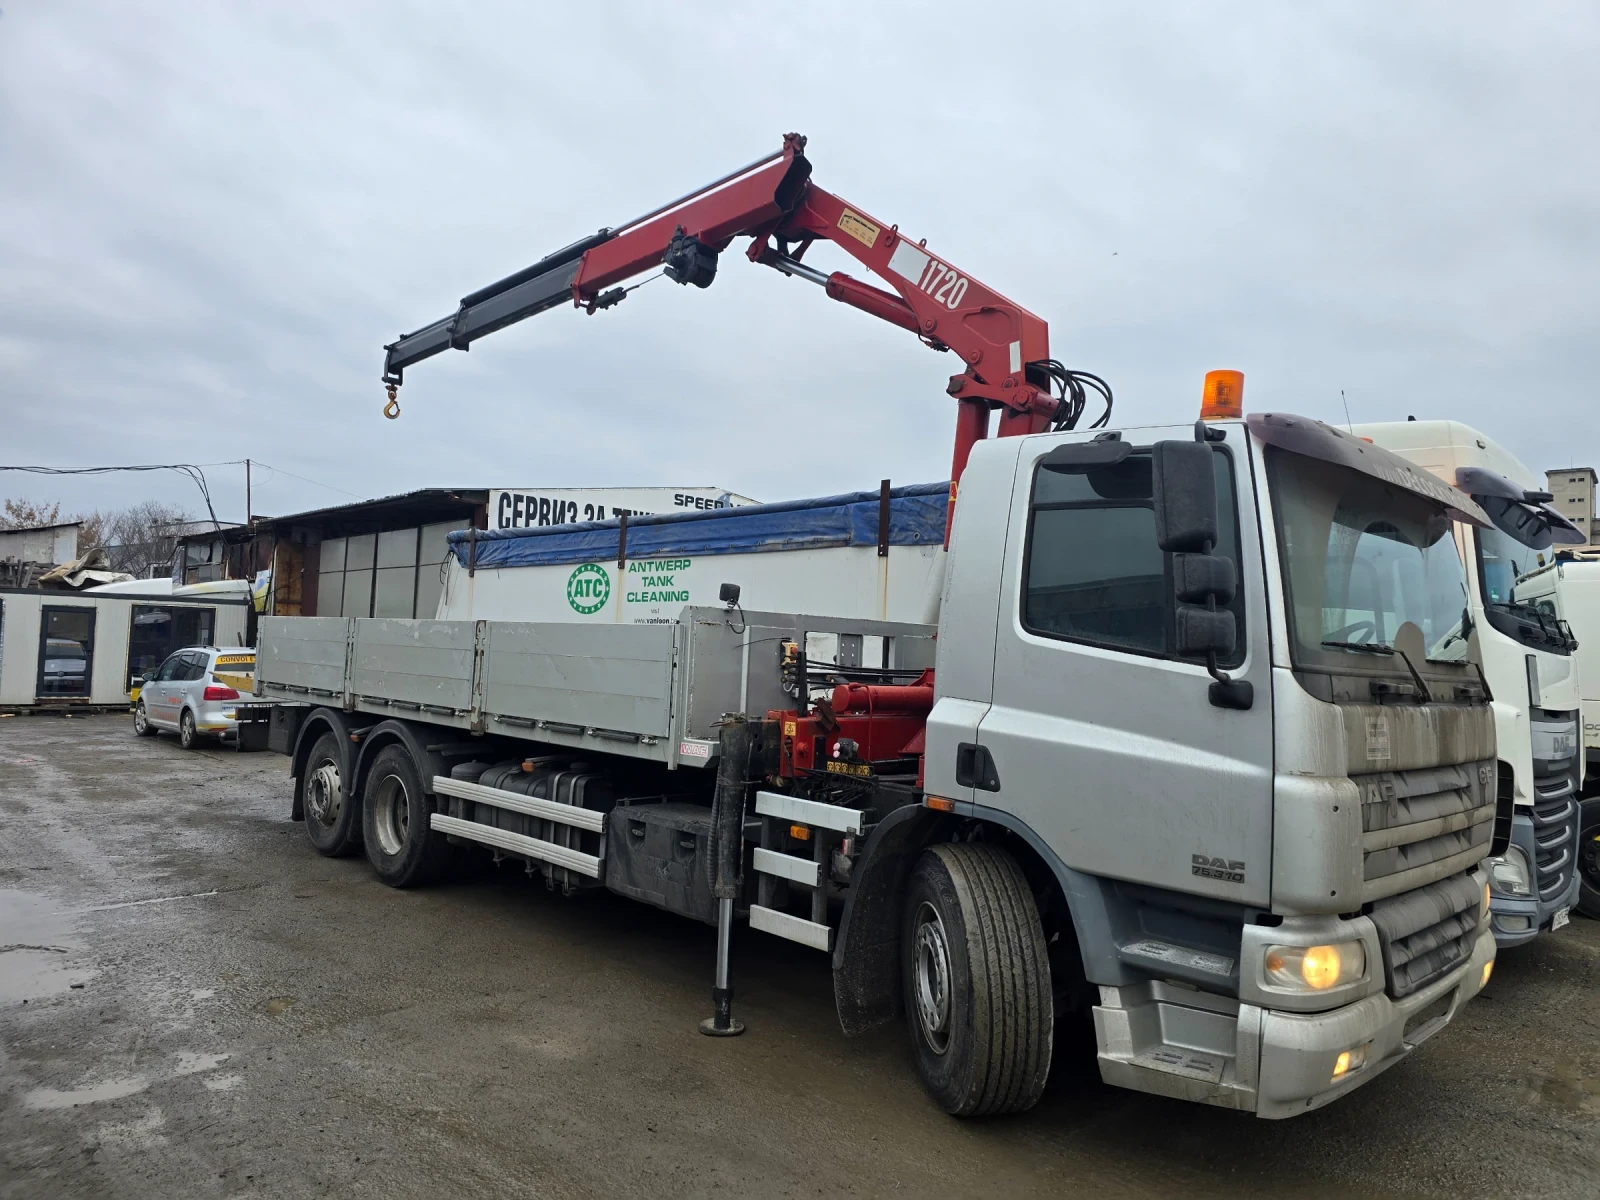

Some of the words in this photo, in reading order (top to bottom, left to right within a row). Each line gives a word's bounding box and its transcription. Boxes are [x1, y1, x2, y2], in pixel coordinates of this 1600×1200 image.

[920, 260, 968, 309] 1720
[674, 493, 724, 510] SPEED
[628, 559, 691, 573] ANTWERP
[573, 578, 603, 598] ATC
[641, 575, 674, 587] TANK
[626, 590, 689, 603] CLEANING
[1192, 854, 1245, 870] DAF
[1192, 866, 1244, 883] 75.310
